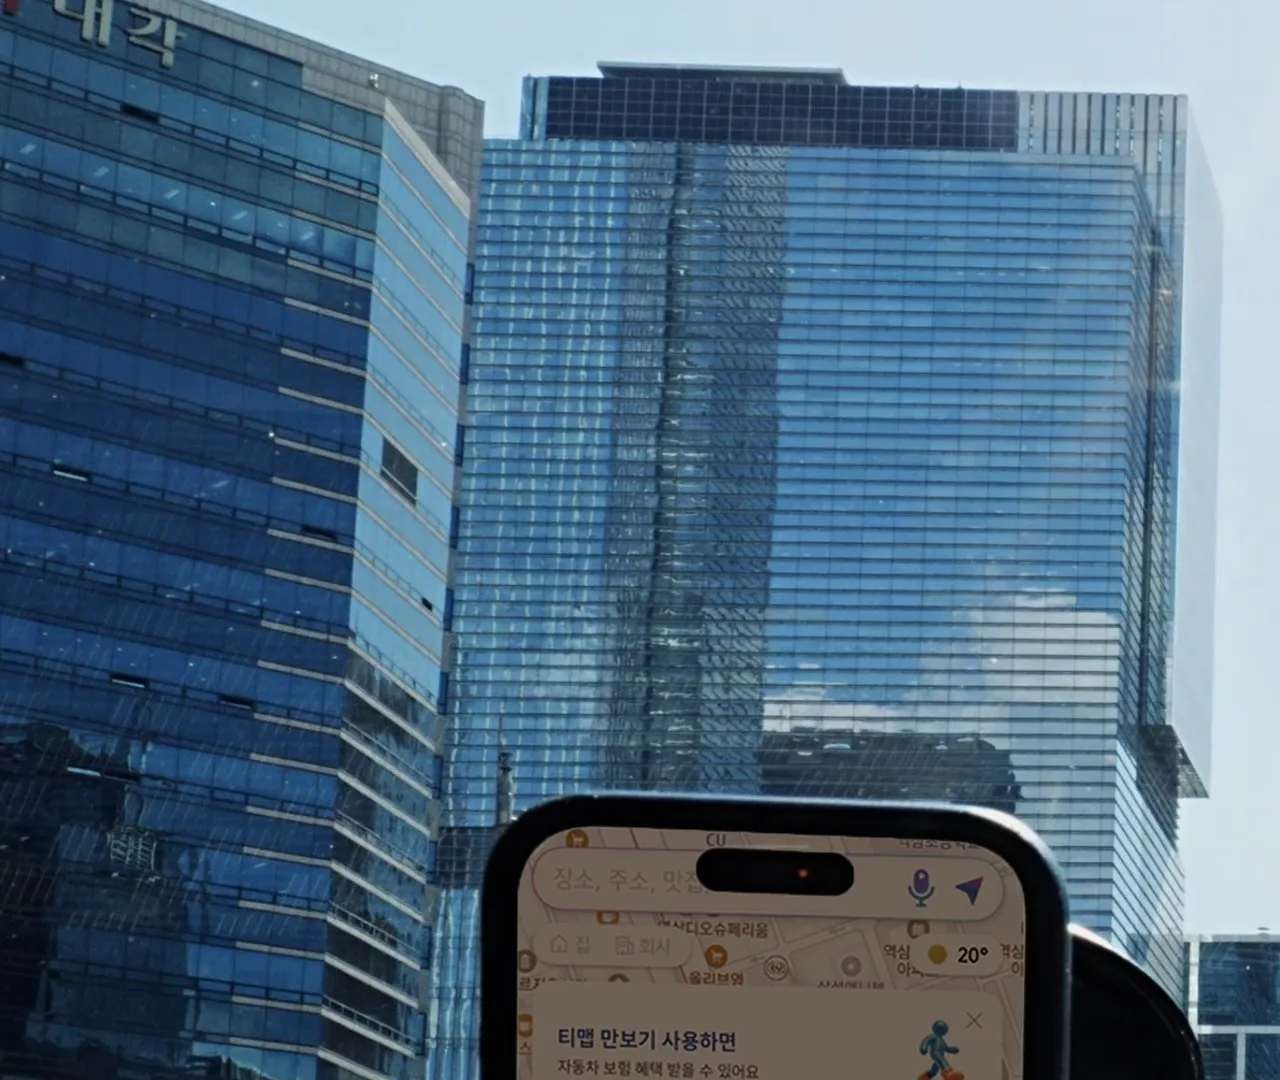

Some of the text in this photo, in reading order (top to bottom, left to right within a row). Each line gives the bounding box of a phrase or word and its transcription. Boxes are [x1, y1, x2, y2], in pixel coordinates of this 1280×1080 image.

[706, 832, 727, 847] CU
[639, 936, 671, 956] 회사
[558, 1027, 736, 1052] 티맵 만보기 사용하면
[557, 1059, 760, 1080] 자동차 보험 혜택 받을 수 있어요
